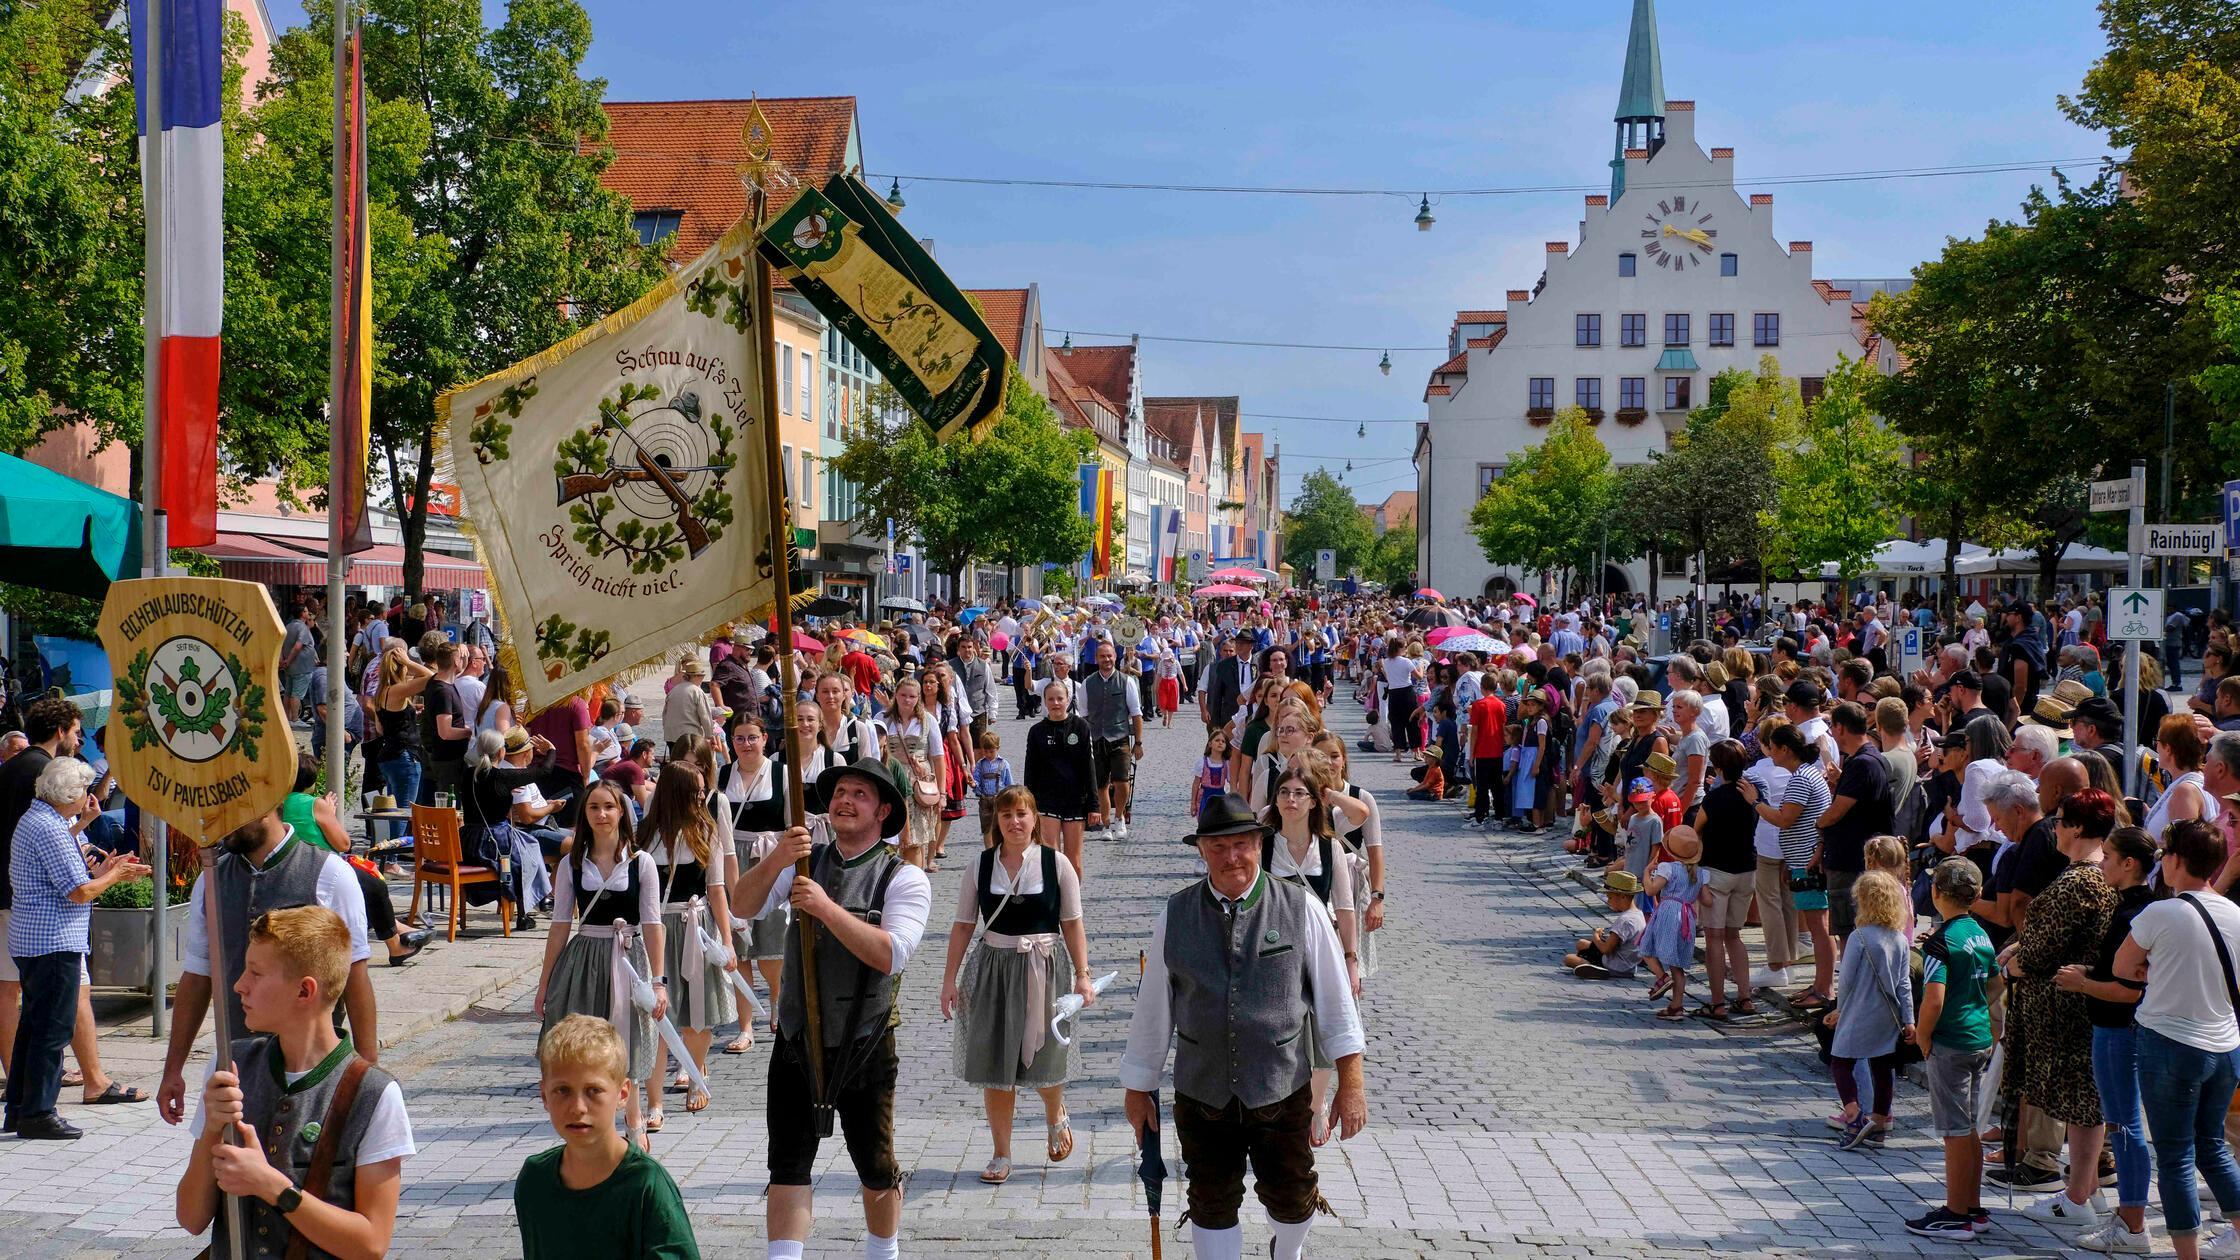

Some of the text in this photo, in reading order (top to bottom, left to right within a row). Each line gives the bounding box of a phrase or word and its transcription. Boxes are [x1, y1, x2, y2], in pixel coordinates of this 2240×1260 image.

[616, 345, 681, 376] Schau
[2229, 489, 2240, 540] P
[539, 524, 684, 599] Sprich nicht viel.
[2150, 530, 2215, 553] Rainbügl
[119, 593, 254, 647] EICHENLAUBSCHÜTZEN
[1907, 633, 1915, 645] P
[147, 766, 251, 808] TSV PAVELSBACH
